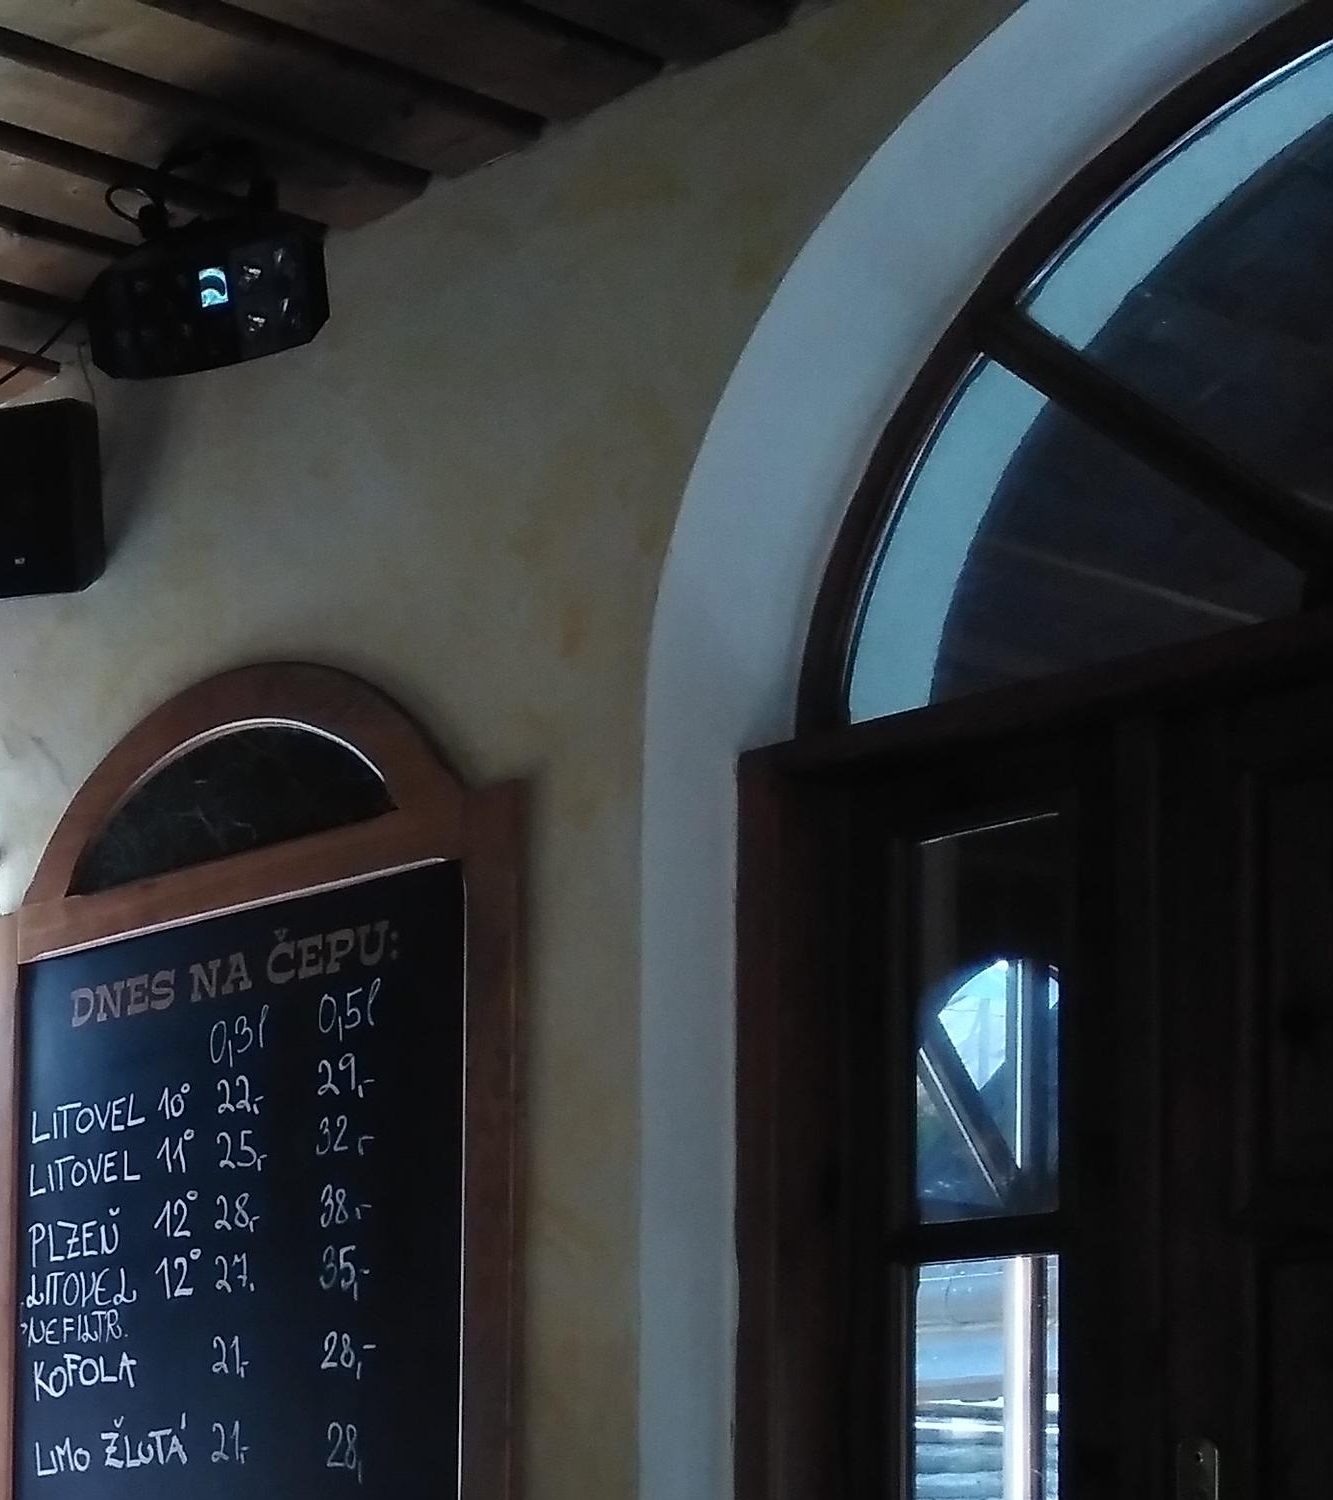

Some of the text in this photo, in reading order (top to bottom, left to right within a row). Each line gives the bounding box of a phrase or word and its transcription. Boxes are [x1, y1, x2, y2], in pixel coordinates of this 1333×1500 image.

[70, 919, 400, 1028] DNES NA ČEPU:
[30, 1093, 146, 1145] LITOVEL
[156, 1082, 191, 1121] 10°
[28, 1150, 142, 1198] LITOVEL
[155, 1128, 195, 1174] 11°
[28, 1206, 121, 1269] PLZEŇ
[153, 1189, 199, 1238] 12°
[25, 1267, 138, 1309] LITOVEL
[154, 1247, 202, 1299] 12°
[33, 1350, 138, 1402] KOFOLA
[34, 1437, 91, 1478] LIMO
[100, 1412, 189, 1469] ŽLUTÁ
